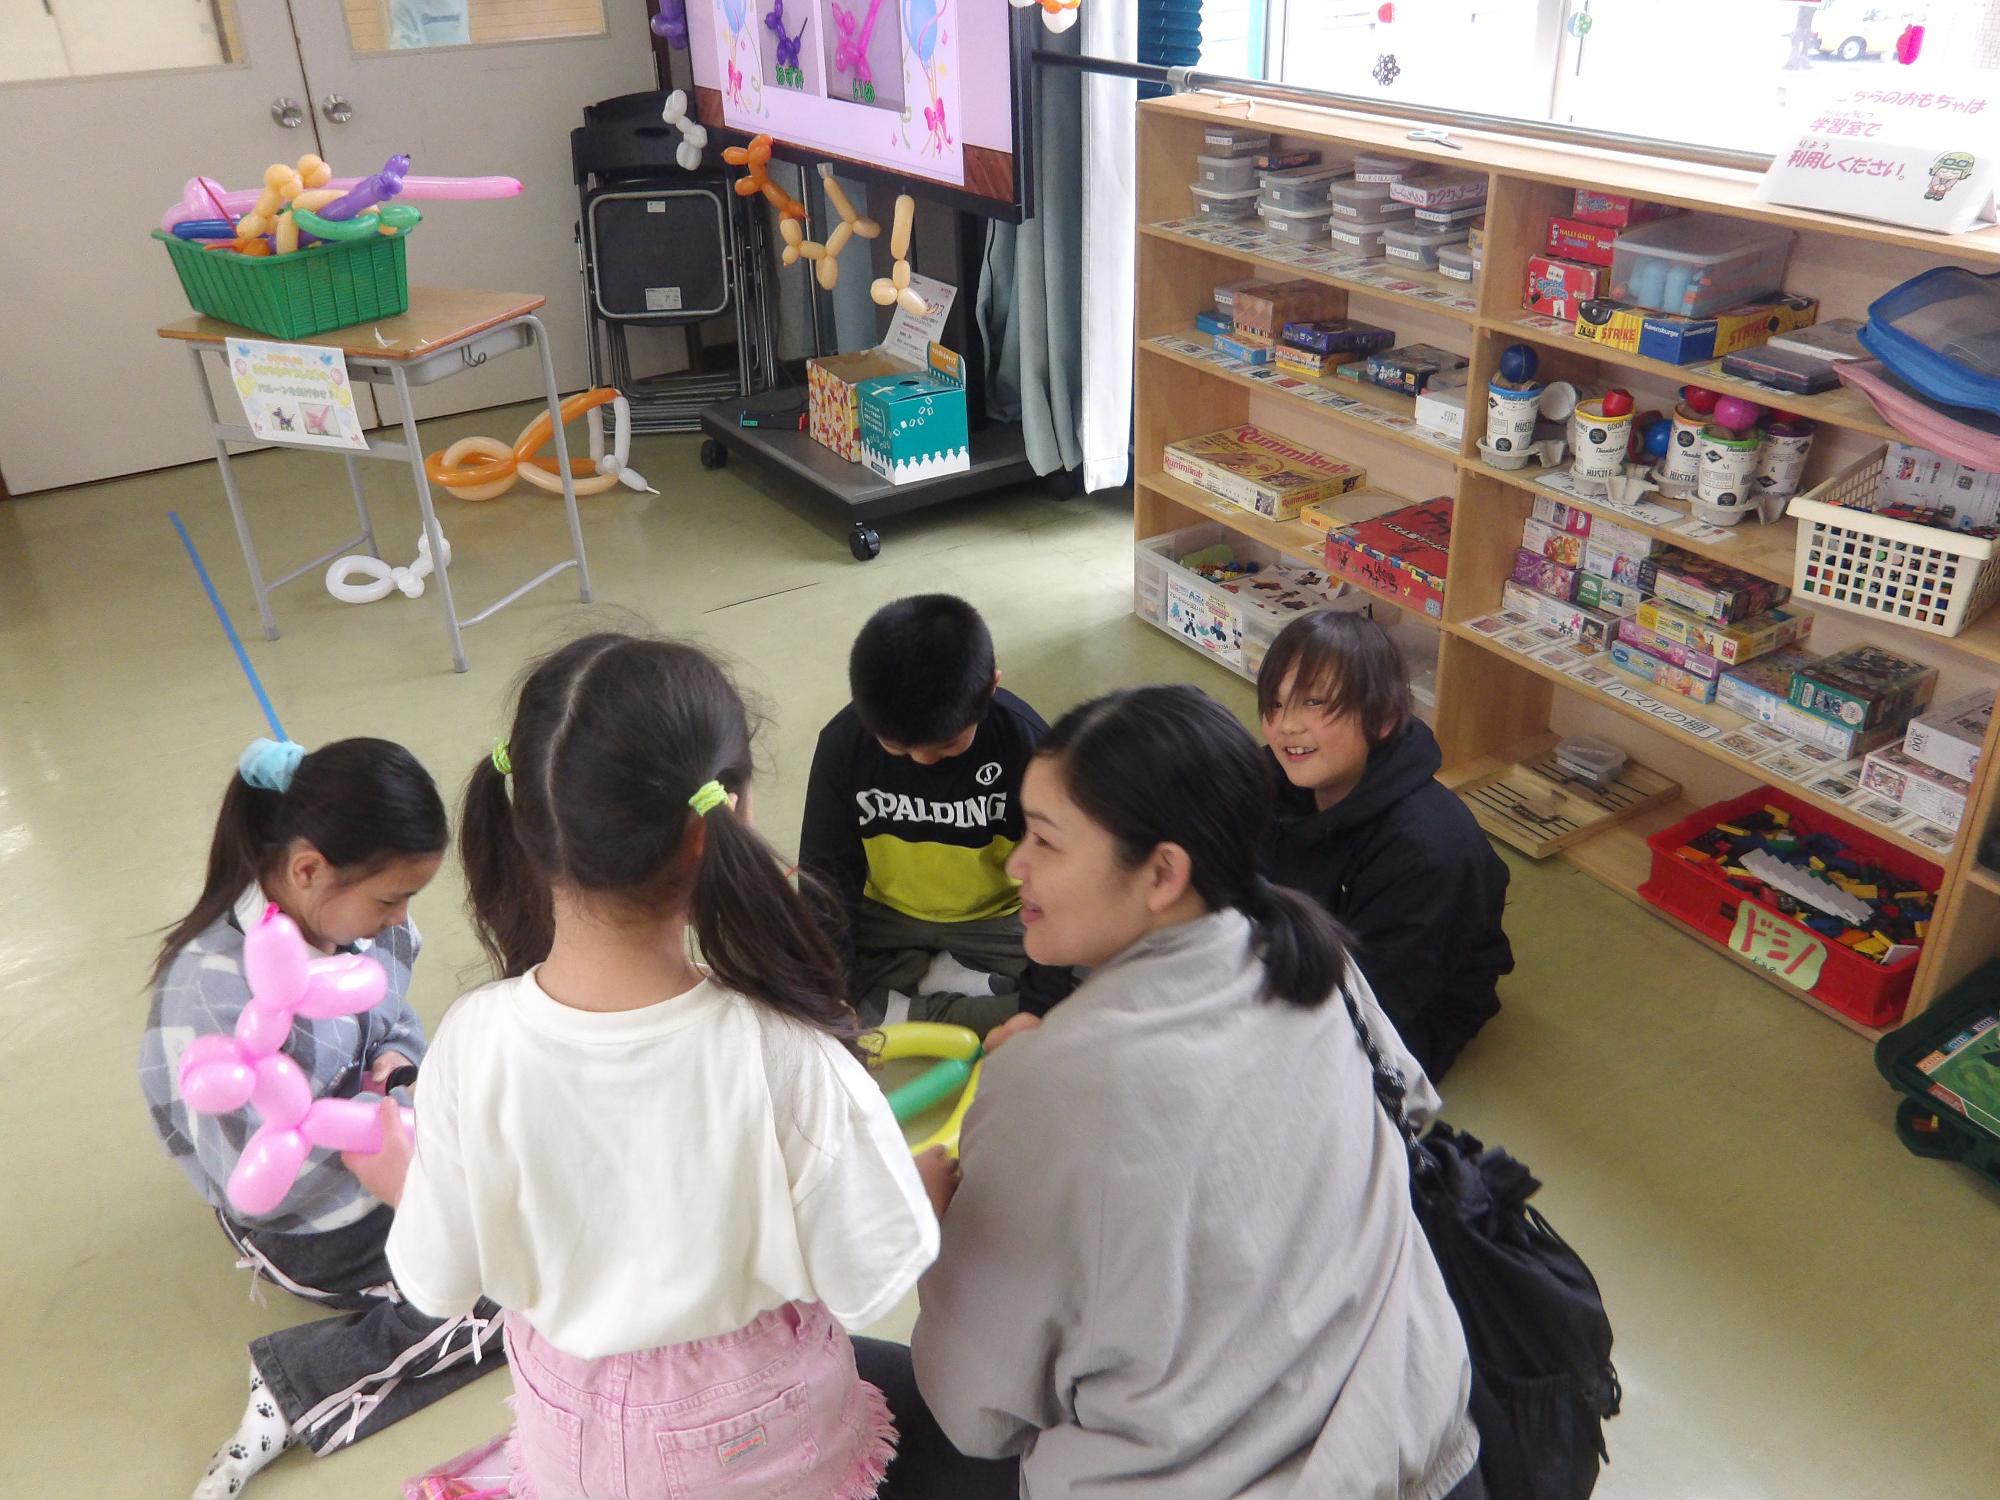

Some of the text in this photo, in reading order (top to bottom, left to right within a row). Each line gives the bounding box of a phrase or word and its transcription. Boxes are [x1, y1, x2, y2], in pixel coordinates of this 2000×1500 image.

[775, 64, 804, 90] ねずみ
[853, 78, 875, 104] いぬ
[1810, 117, 1883, 137] 学習室で
[1799, 140, 1830, 150] りよう
[1786, 150, 1905, 180] 利用しください。
[1601, 327, 1637, 343] STRIKE
[1643, 322, 1679, 338] Ravensburger
[1728, 317, 1769, 346] STRIKE
[1236, 426, 1351, 474] Rummikub
[1164, 456, 1203, 479] Rummikub
[1586, 469, 1613, 478] HUSTLE
[1669, 471, 1697, 483] HUSTLE
[1282, 491, 1320, 507] Rummikub
[1604, 686, 1709, 731] パズルの棚
[855, 788, 1007, 828] SPALDING
[1740, 908, 1818, 975] ドミノ
